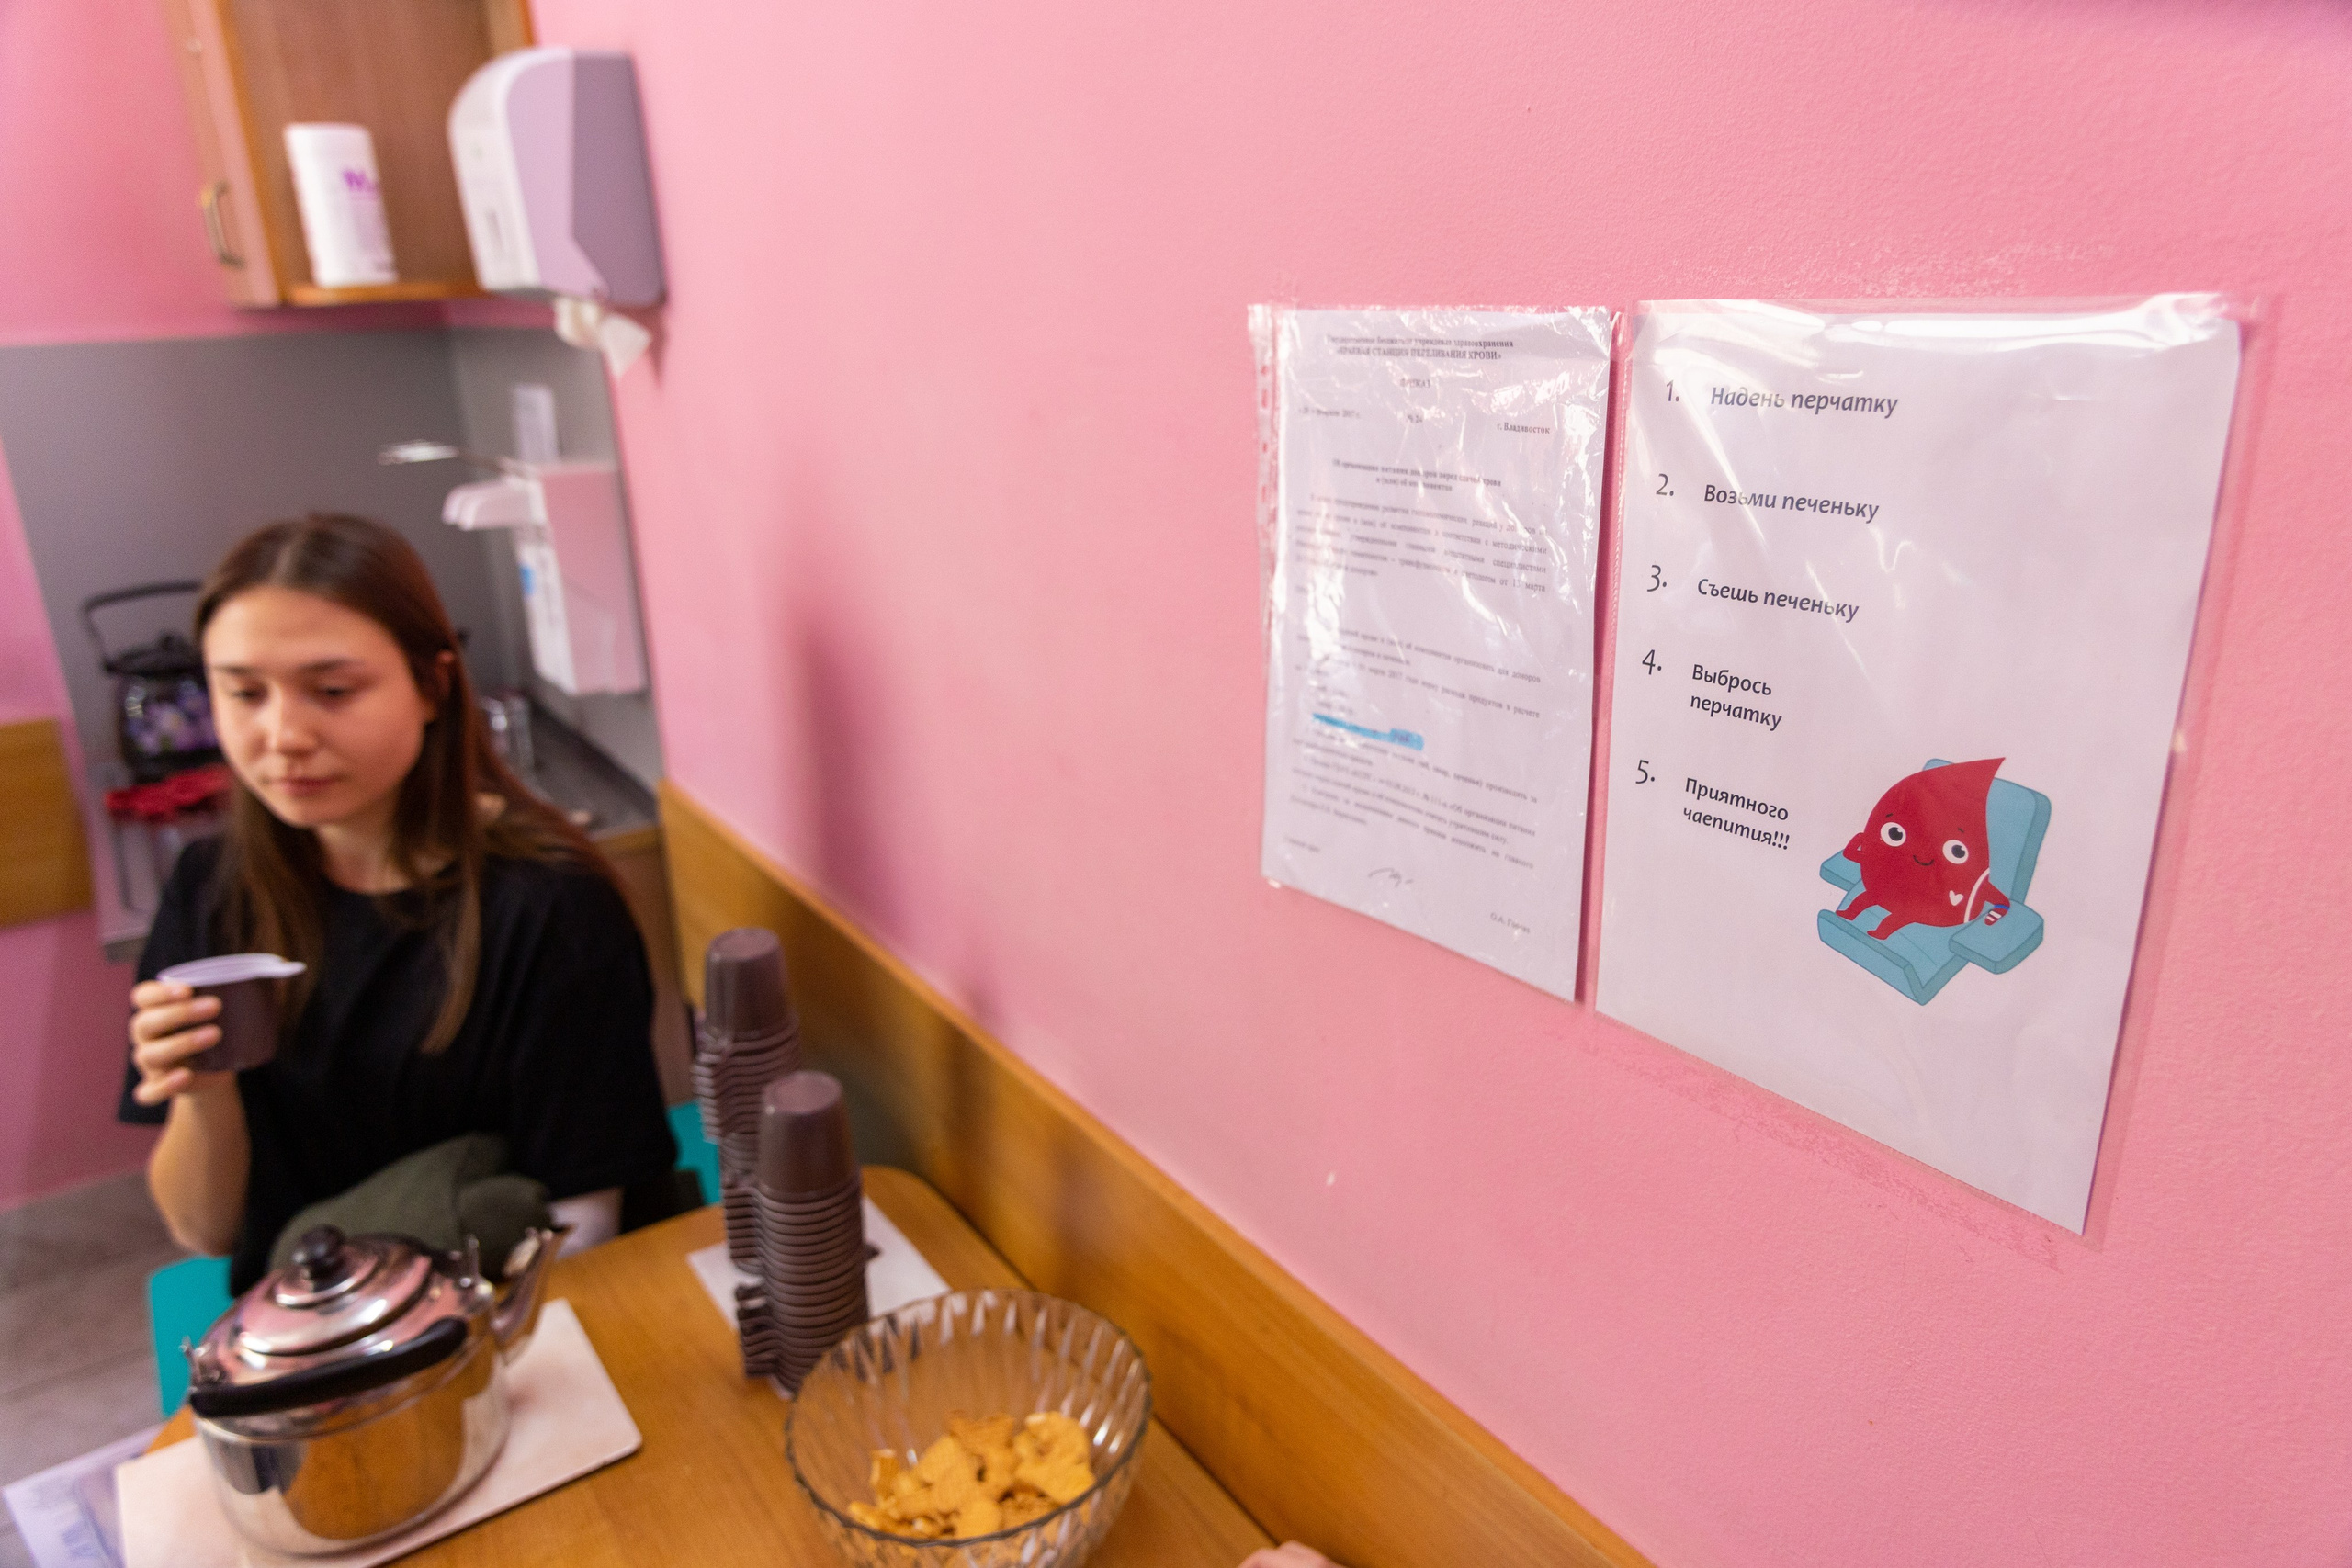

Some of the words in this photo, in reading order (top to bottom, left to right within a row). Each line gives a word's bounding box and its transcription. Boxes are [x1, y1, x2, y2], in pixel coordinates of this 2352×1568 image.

[1468, 350, 1501, 360] КРОВИ»
[1666, 379, 1680, 402] 1.
[1710, 386, 1785, 408] Надень
[1790, 392, 1898, 419] перчатку
[1503, 422, 1551, 434] Владивосток
[1656, 473, 1675, 497] 2.
[1703, 484, 1777, 509] Возьми
[1781, 494, 1879, 524] печеньку
[1646, 565, 1668, 592] 3.
[1697, 578, 1758, 604] Съешь
[1763, 592, 1860, 623] печеньку
[1642, 649, 1662, 675] 4.
[1691, 663, 1772, 695] Выбрось
[1690, 694, 1782, 731] перчатку
[1635, 760, 1656, 784] 5.
[1685, 777, 1789, 821] Приятного
[1682, 807, 1791, 851] чаепития!!!
